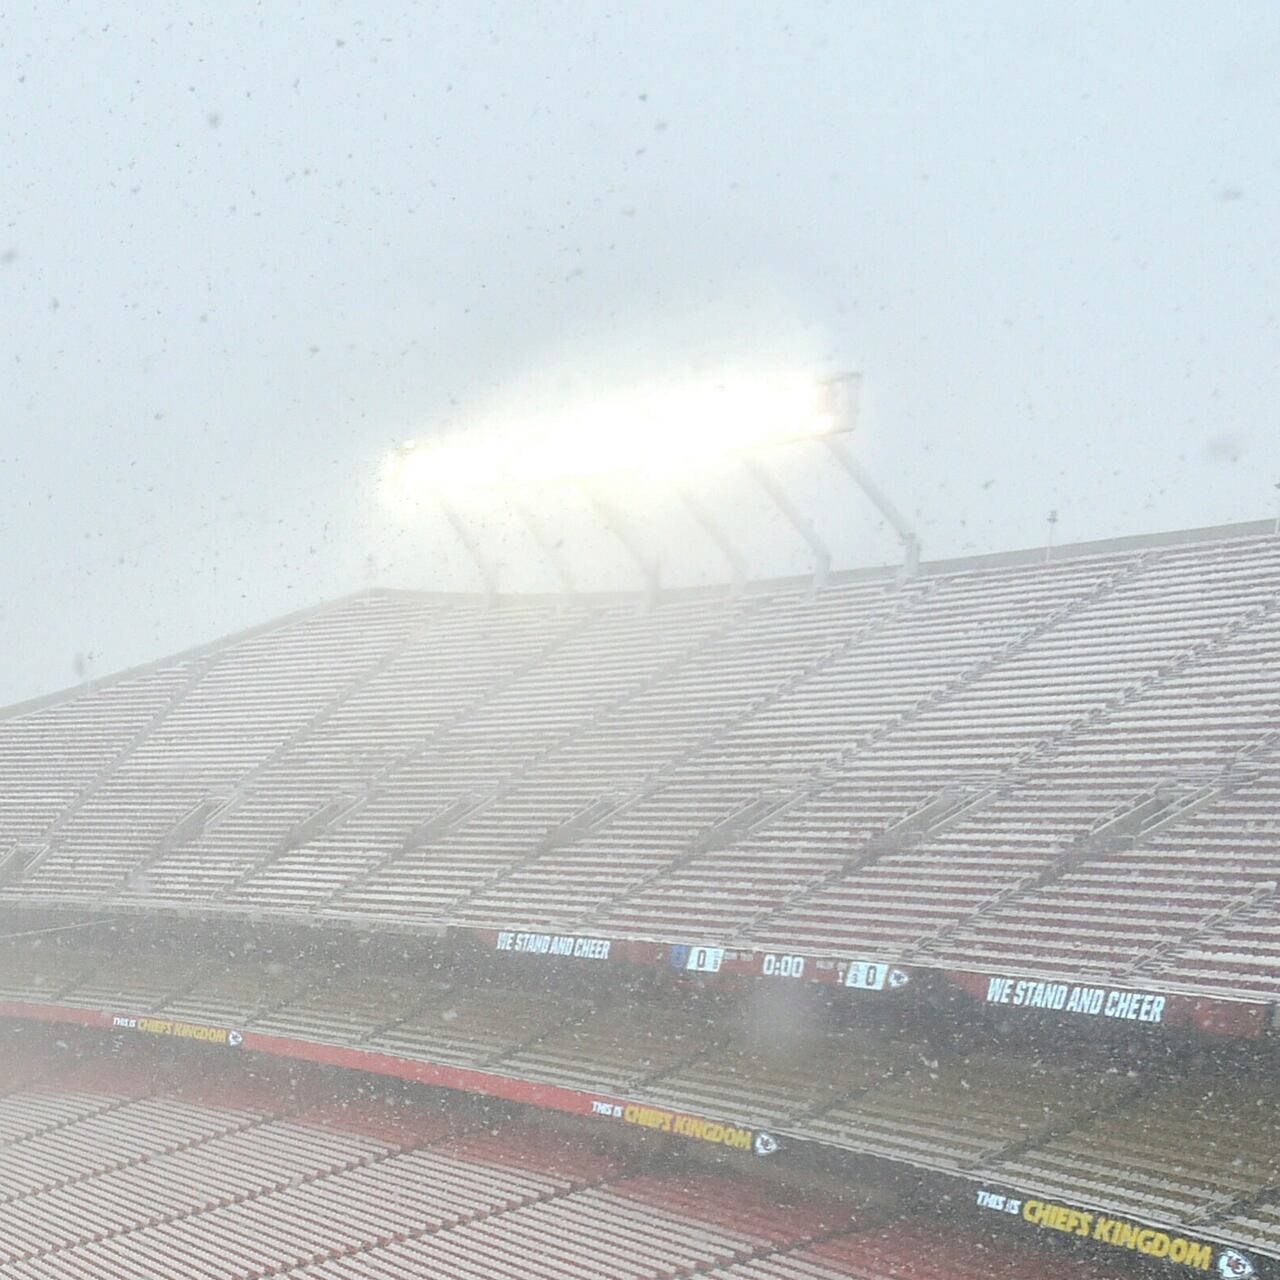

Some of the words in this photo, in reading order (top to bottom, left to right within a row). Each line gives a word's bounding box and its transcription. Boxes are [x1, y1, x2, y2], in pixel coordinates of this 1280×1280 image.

[496, 932, 515, 950] WE
[515, 933, 550, 954] STAND
[549, 936, 574, 956] AND
[574, 938, 610, 959] CHEER
[697, 949, 706, 968] 0
[763, 953, 804, 978] 0:00
[866, 965, 876, 986] 0
[987, 977, 1014, 1003] WE
[1013, 980, 1068, 1010] STAND
[1066, 986, 1105, 1015] AND
[1104, 991, 1166, 1023] CHEER
[138, 1019, 173, 1034] CHIEFS
[174, 1022, 226, 1042] KINGDOM
[592, 1101, 612, 1115] THIS
[612, 1105, 623, 1117] IS
[624, 1104, 674, 1131] CHIEFS
[674, 1115, 752, 1150] KINGDOM
[976, 1191, 1007, 1211] THIS
[1006, 1199, 1021, 1215] IS
[1023, 1200, 1093, 1236] CHIEFS
[1093, 1216, 1212, 1271] KINGDOM
